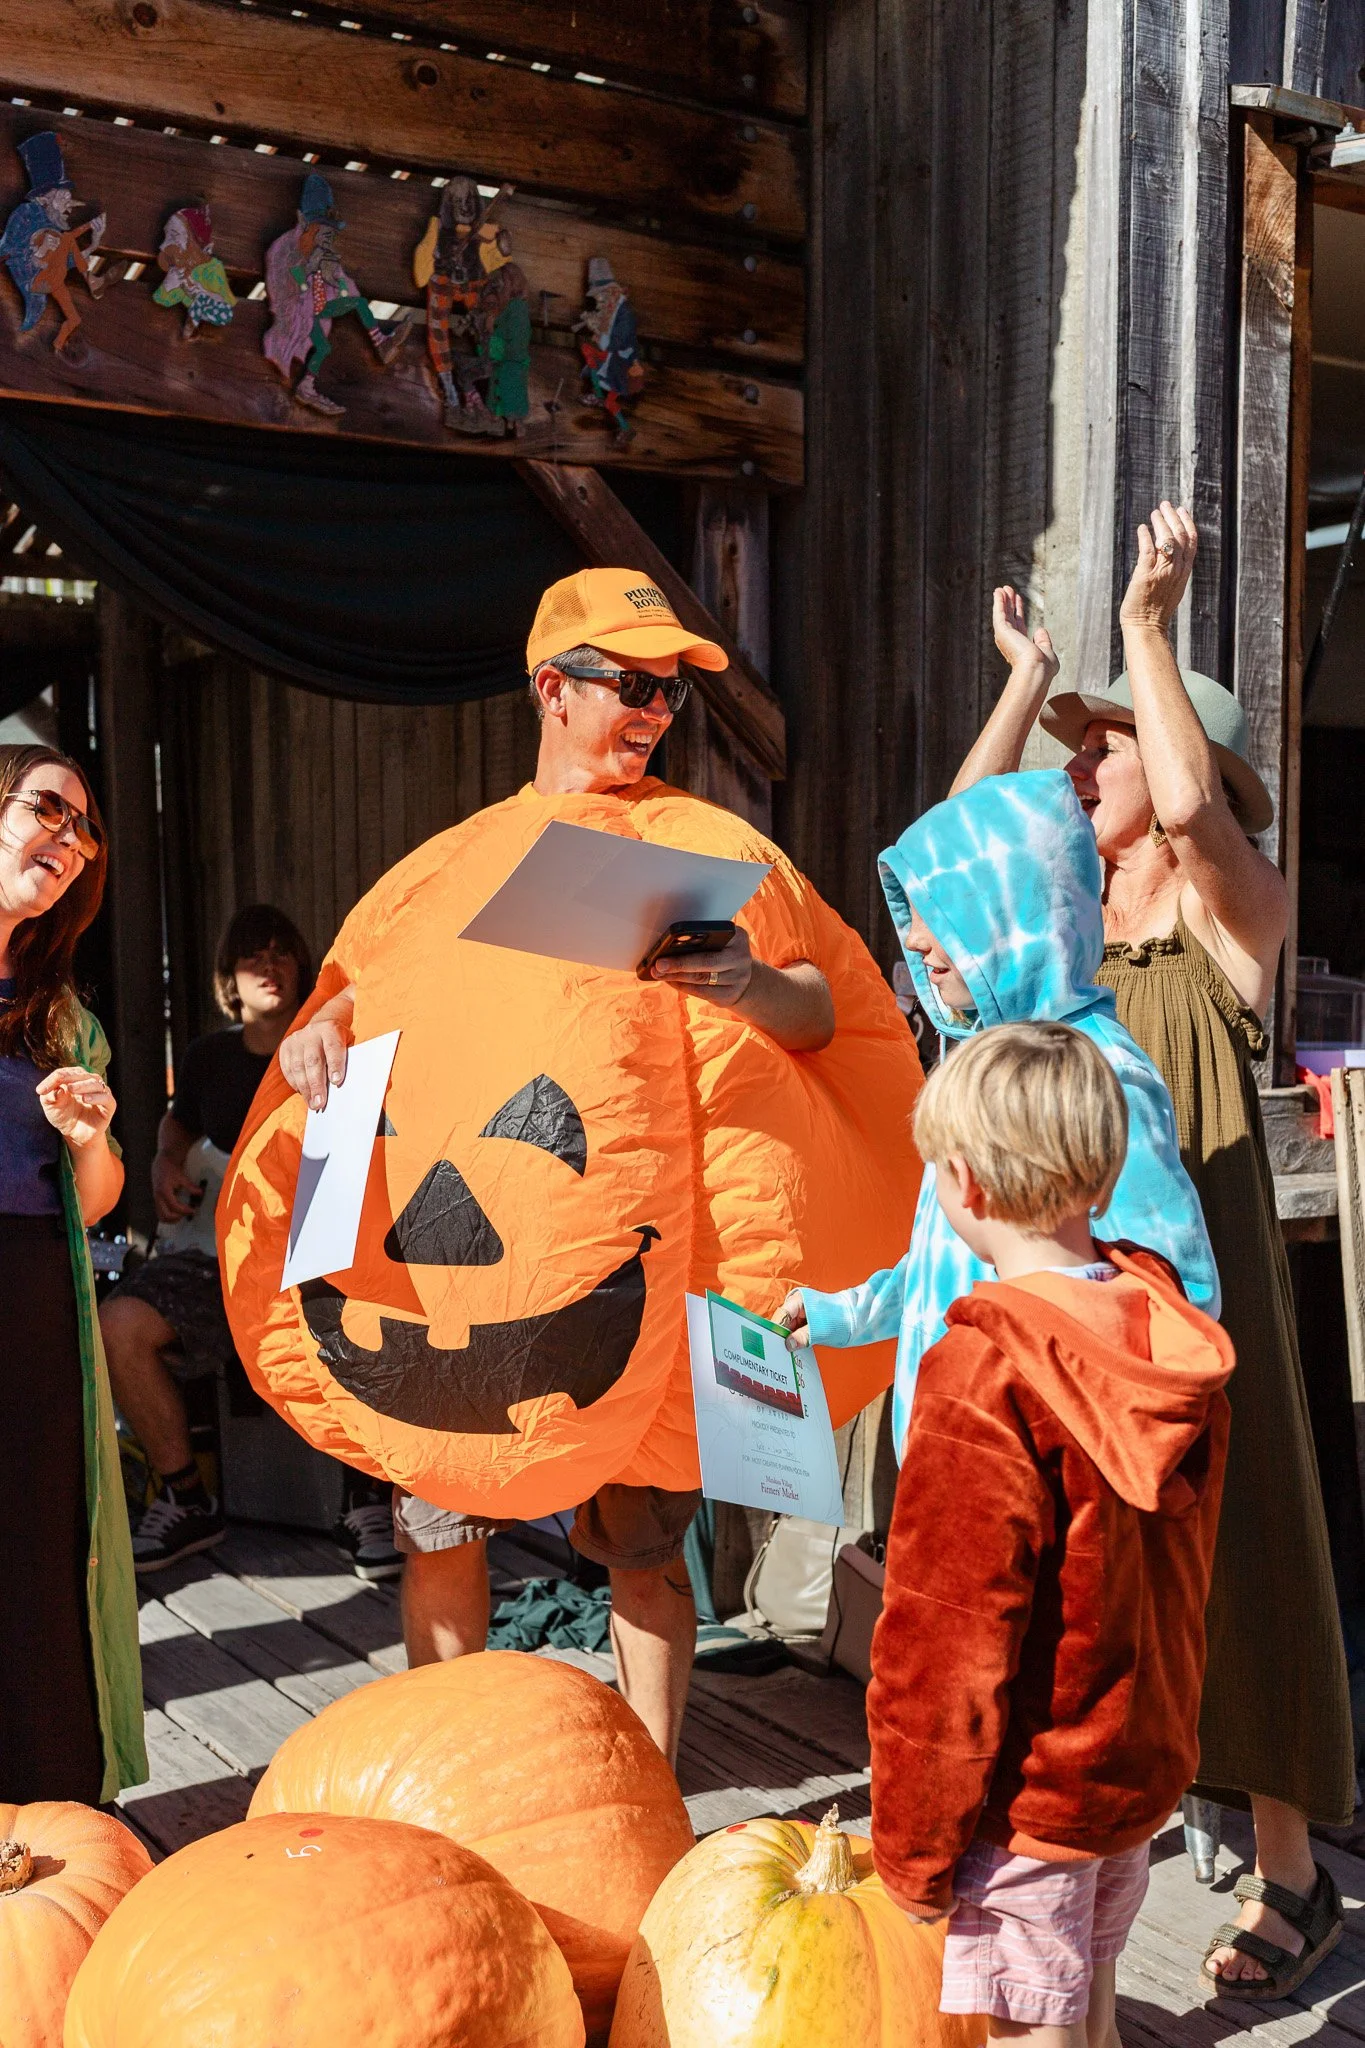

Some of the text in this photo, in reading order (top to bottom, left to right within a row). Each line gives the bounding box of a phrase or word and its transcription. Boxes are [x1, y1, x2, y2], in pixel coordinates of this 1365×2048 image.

[723, 1348, 788, 1385] COMPLIMENTARY TICKET
[781, 1487, 799, 1500] Market
